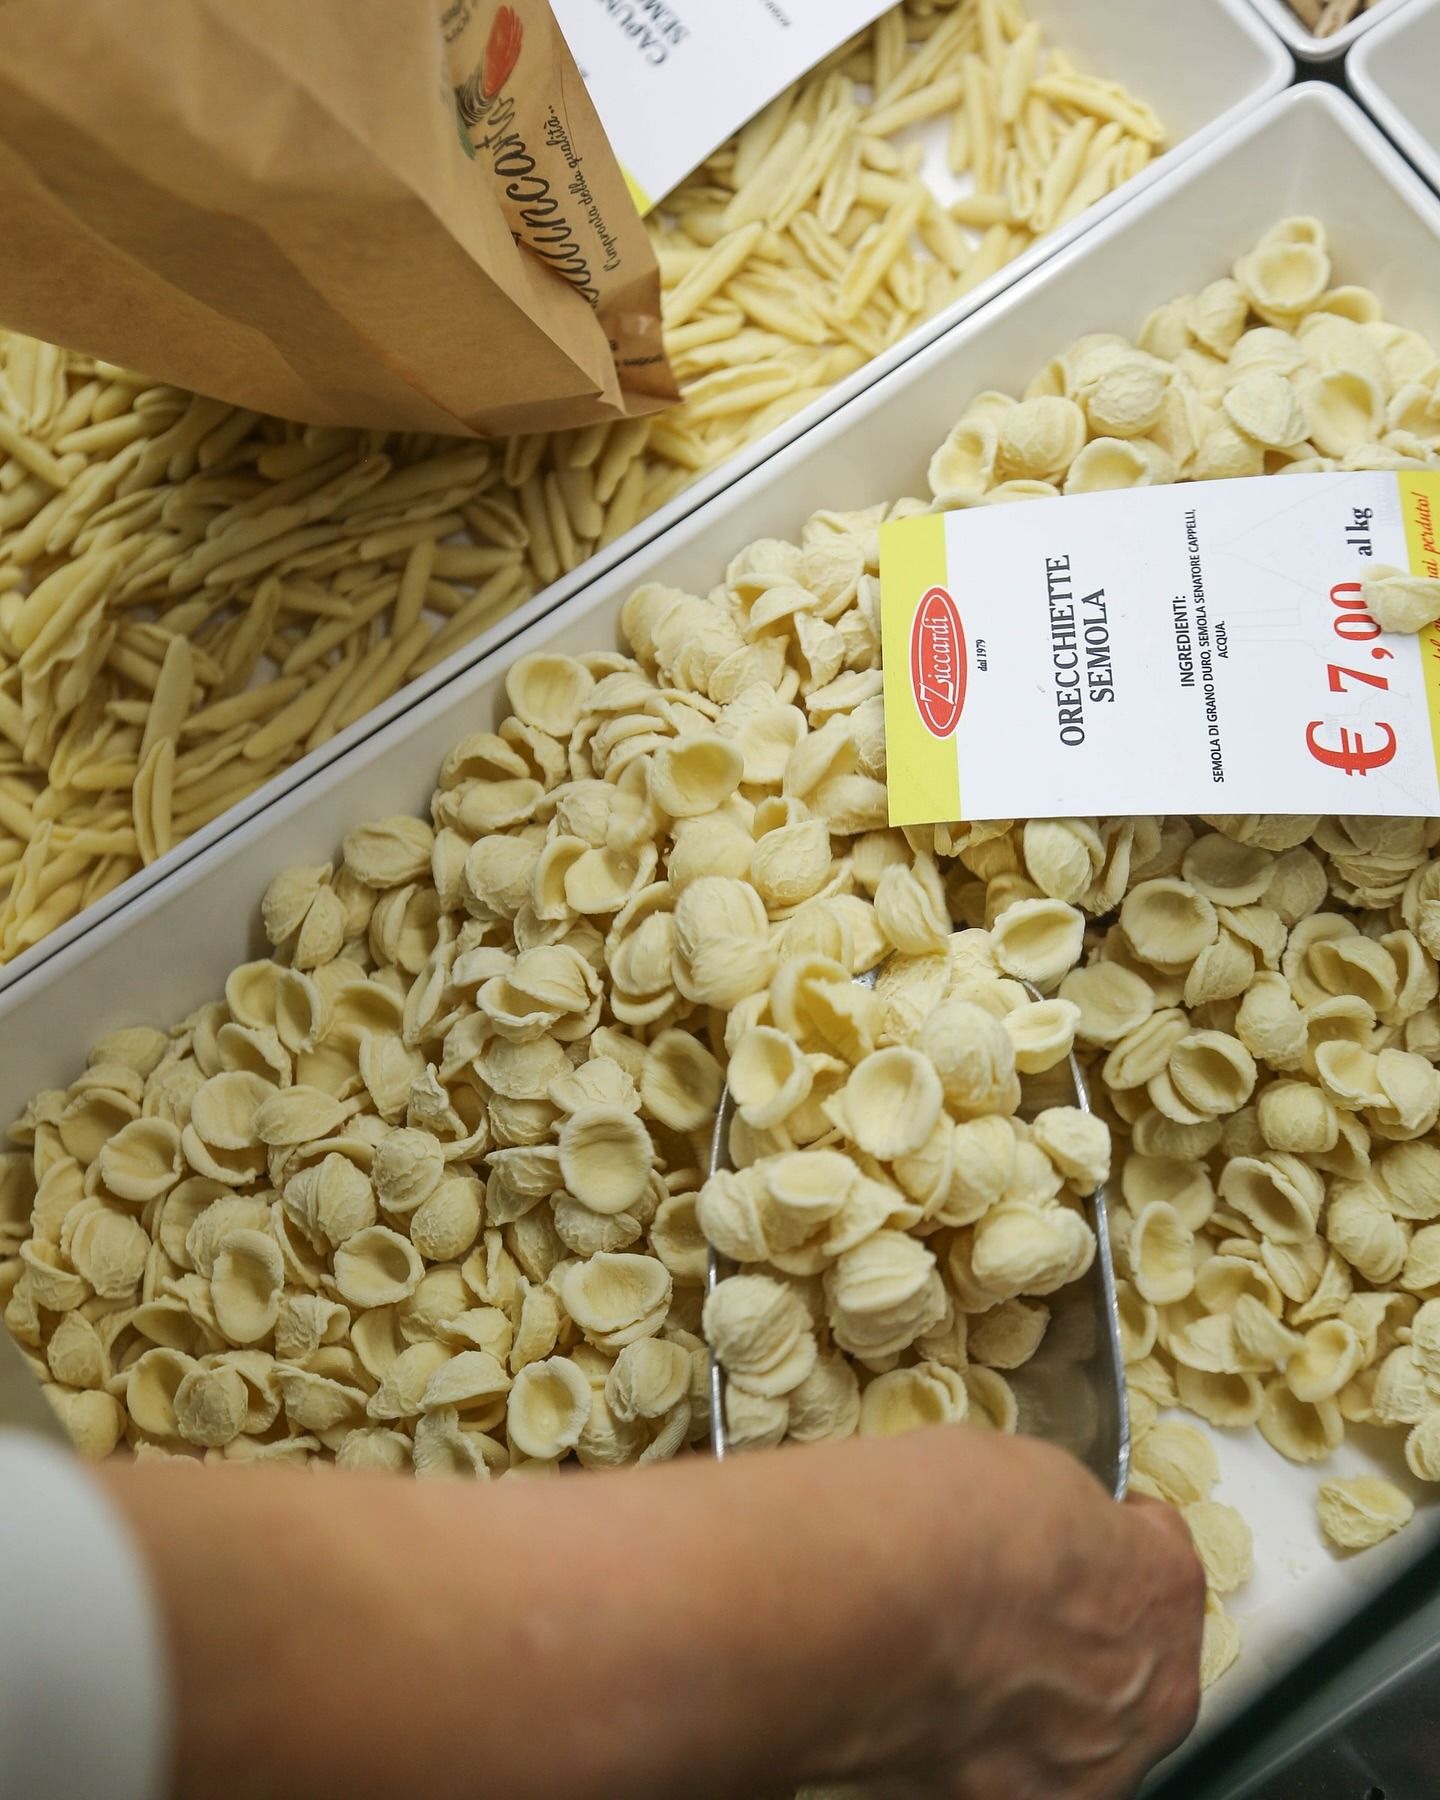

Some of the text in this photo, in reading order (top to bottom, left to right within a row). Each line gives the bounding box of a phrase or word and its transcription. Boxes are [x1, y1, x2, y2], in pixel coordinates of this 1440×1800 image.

[568, 171, 592, 206] della
[1411, 492, 1440, 556] perduto!
[919, 615, 956, 705] Ziccardi
[975, 638, 988, 672] dal 1979
[1045, 554, 1085, 746] ORECCHIETTE
[1081, 588, 1115, 703] SEMOLA
[1172, 595, 1195, 687] INGREDIENTI:
[1185, 508, 1224, 783] SEMOLA DI GRANO DURO, SEMOLA SENATORE CAPPELLI,
[1215, 620, 1229, 659] ACQUA.
[1305, 507, 1397, 777] € 7,00 al kg
